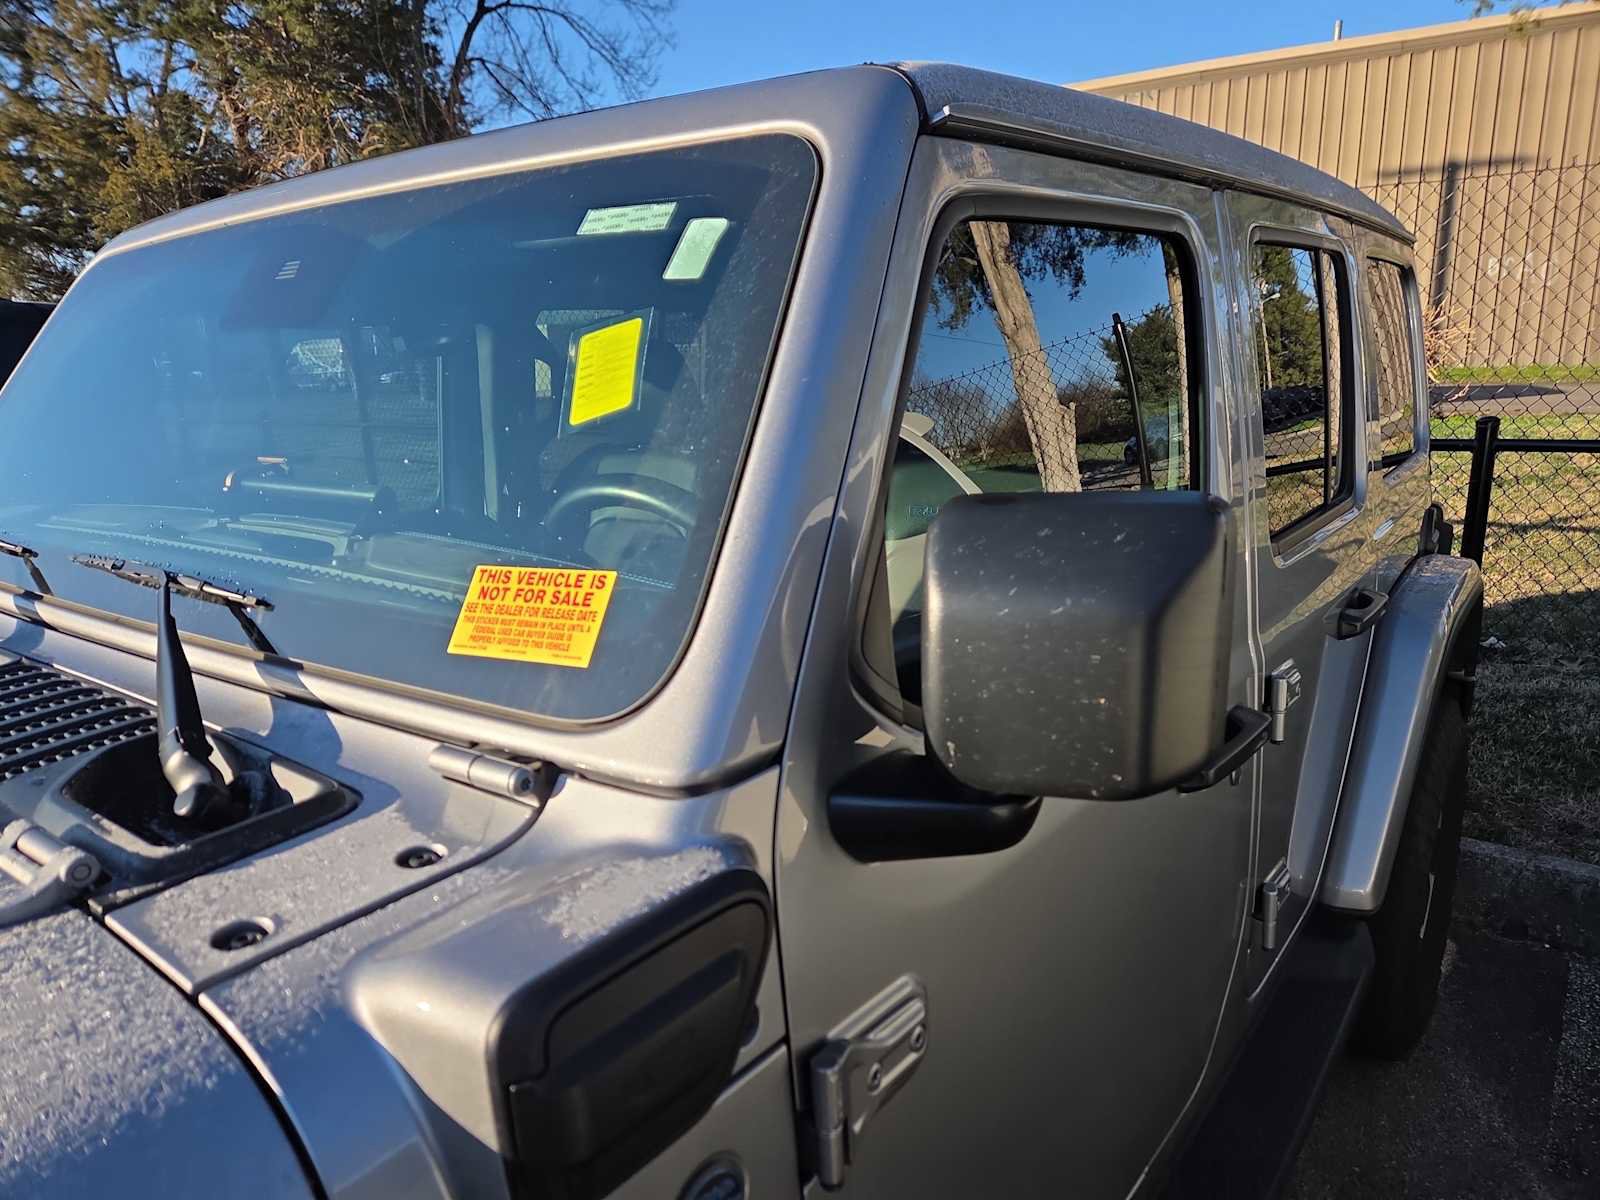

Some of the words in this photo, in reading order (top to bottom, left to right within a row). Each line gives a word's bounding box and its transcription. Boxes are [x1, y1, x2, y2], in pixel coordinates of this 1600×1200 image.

[479, 570, 512, 584] THIS
[517, 571, 585, 587] VEHICLE
[591, 574, 607, 588] IS
[479, 586, 509, 601] NOT
[514, 588, 546, 603] FOR
[551, 590, 594, 606] SALE
[464, 603, 478, 612] SEE
[479, 604, 494, 613] THE
[494, 605, 523, 615] DEALER
[524, 607, 539, 617] FOR
[541, 608, 575, 619] RELEASE
[576, 610, 597, 621] DATE
[547, 621, 566, 629] PLACE
